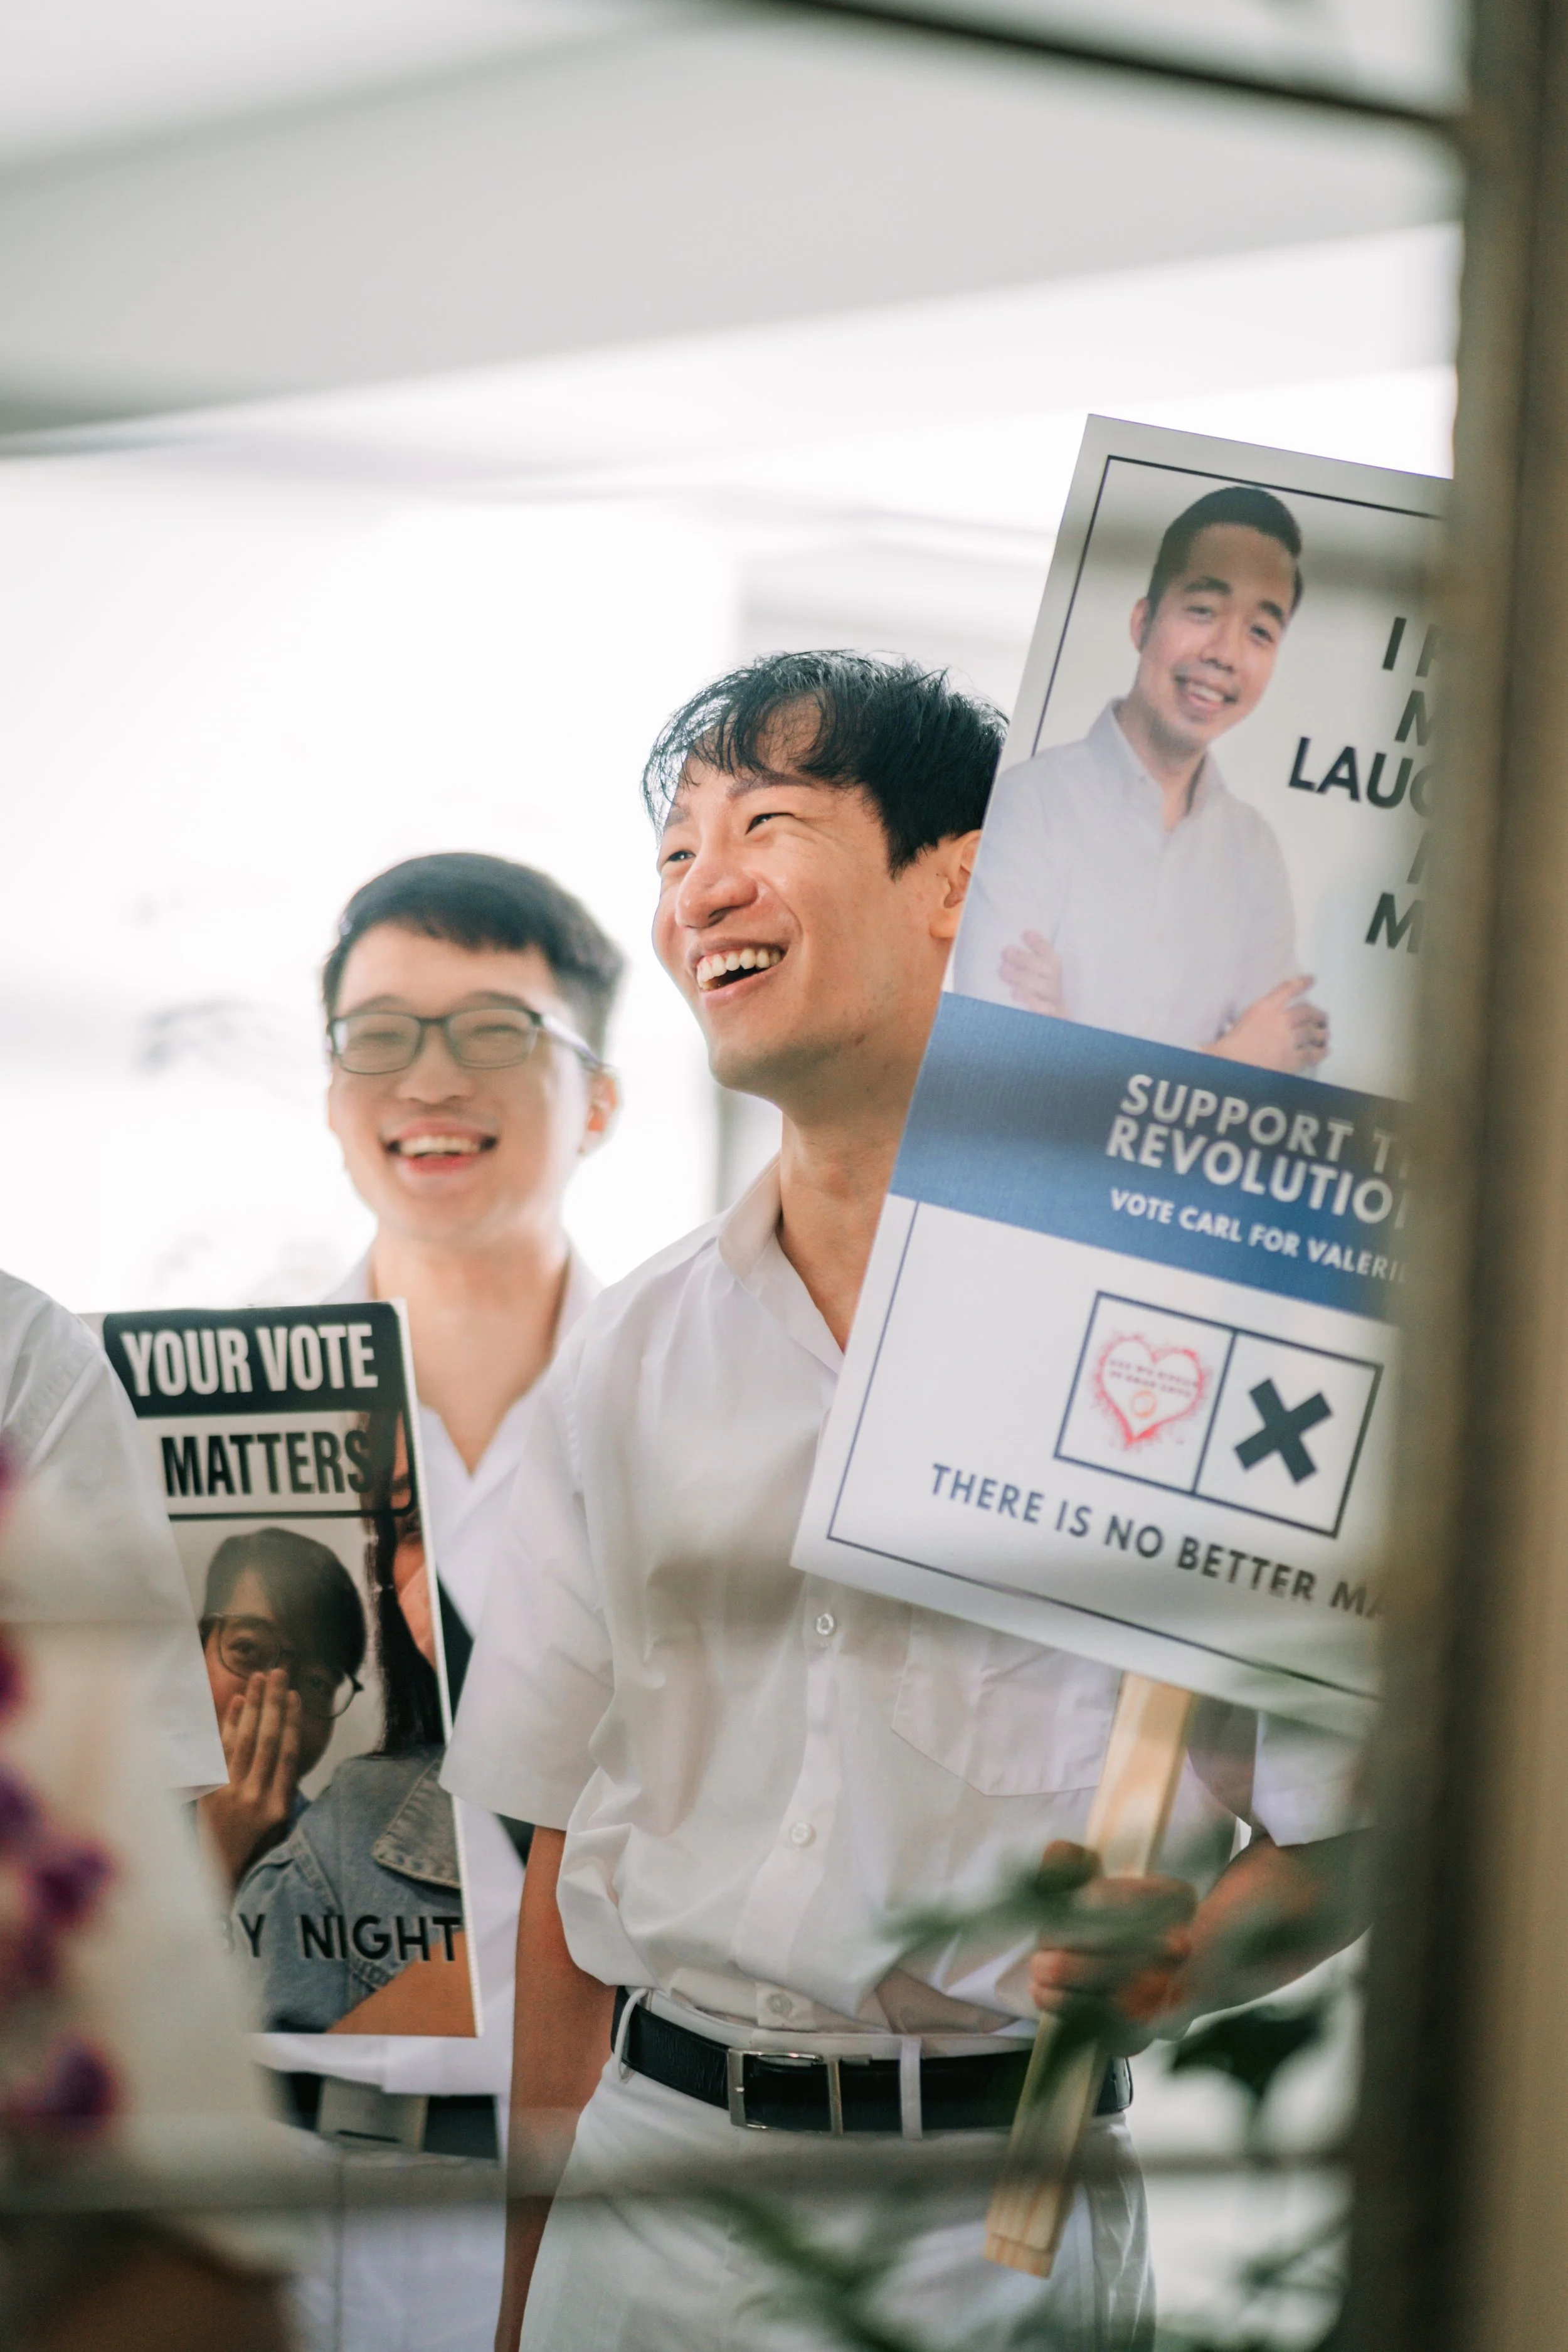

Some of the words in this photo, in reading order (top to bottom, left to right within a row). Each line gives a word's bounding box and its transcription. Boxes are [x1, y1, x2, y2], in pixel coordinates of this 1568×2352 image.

[1120, 1074, 1353, 1158] SUPPORT
[1110, 1188, 1173, 1224] VOTE
[1179, 1207, 1242, 1243] CARL
[1248, 1224, 1300, 1258] FOR
[120, 1328, 253, 1397] YOUR
[255, 1323, 378, 1392] VOTE
[161, 1429, 378, 1497] MATTERS
[931, 1463, 1045, 1524] THERE
[1055, 1501, 1093, 1538] IS
[1104, 1515, 1164, 1559] NO
[1177, 1536, 1317, 1603] BETTER
[299, 1913, 463, 1962] NIGHT
